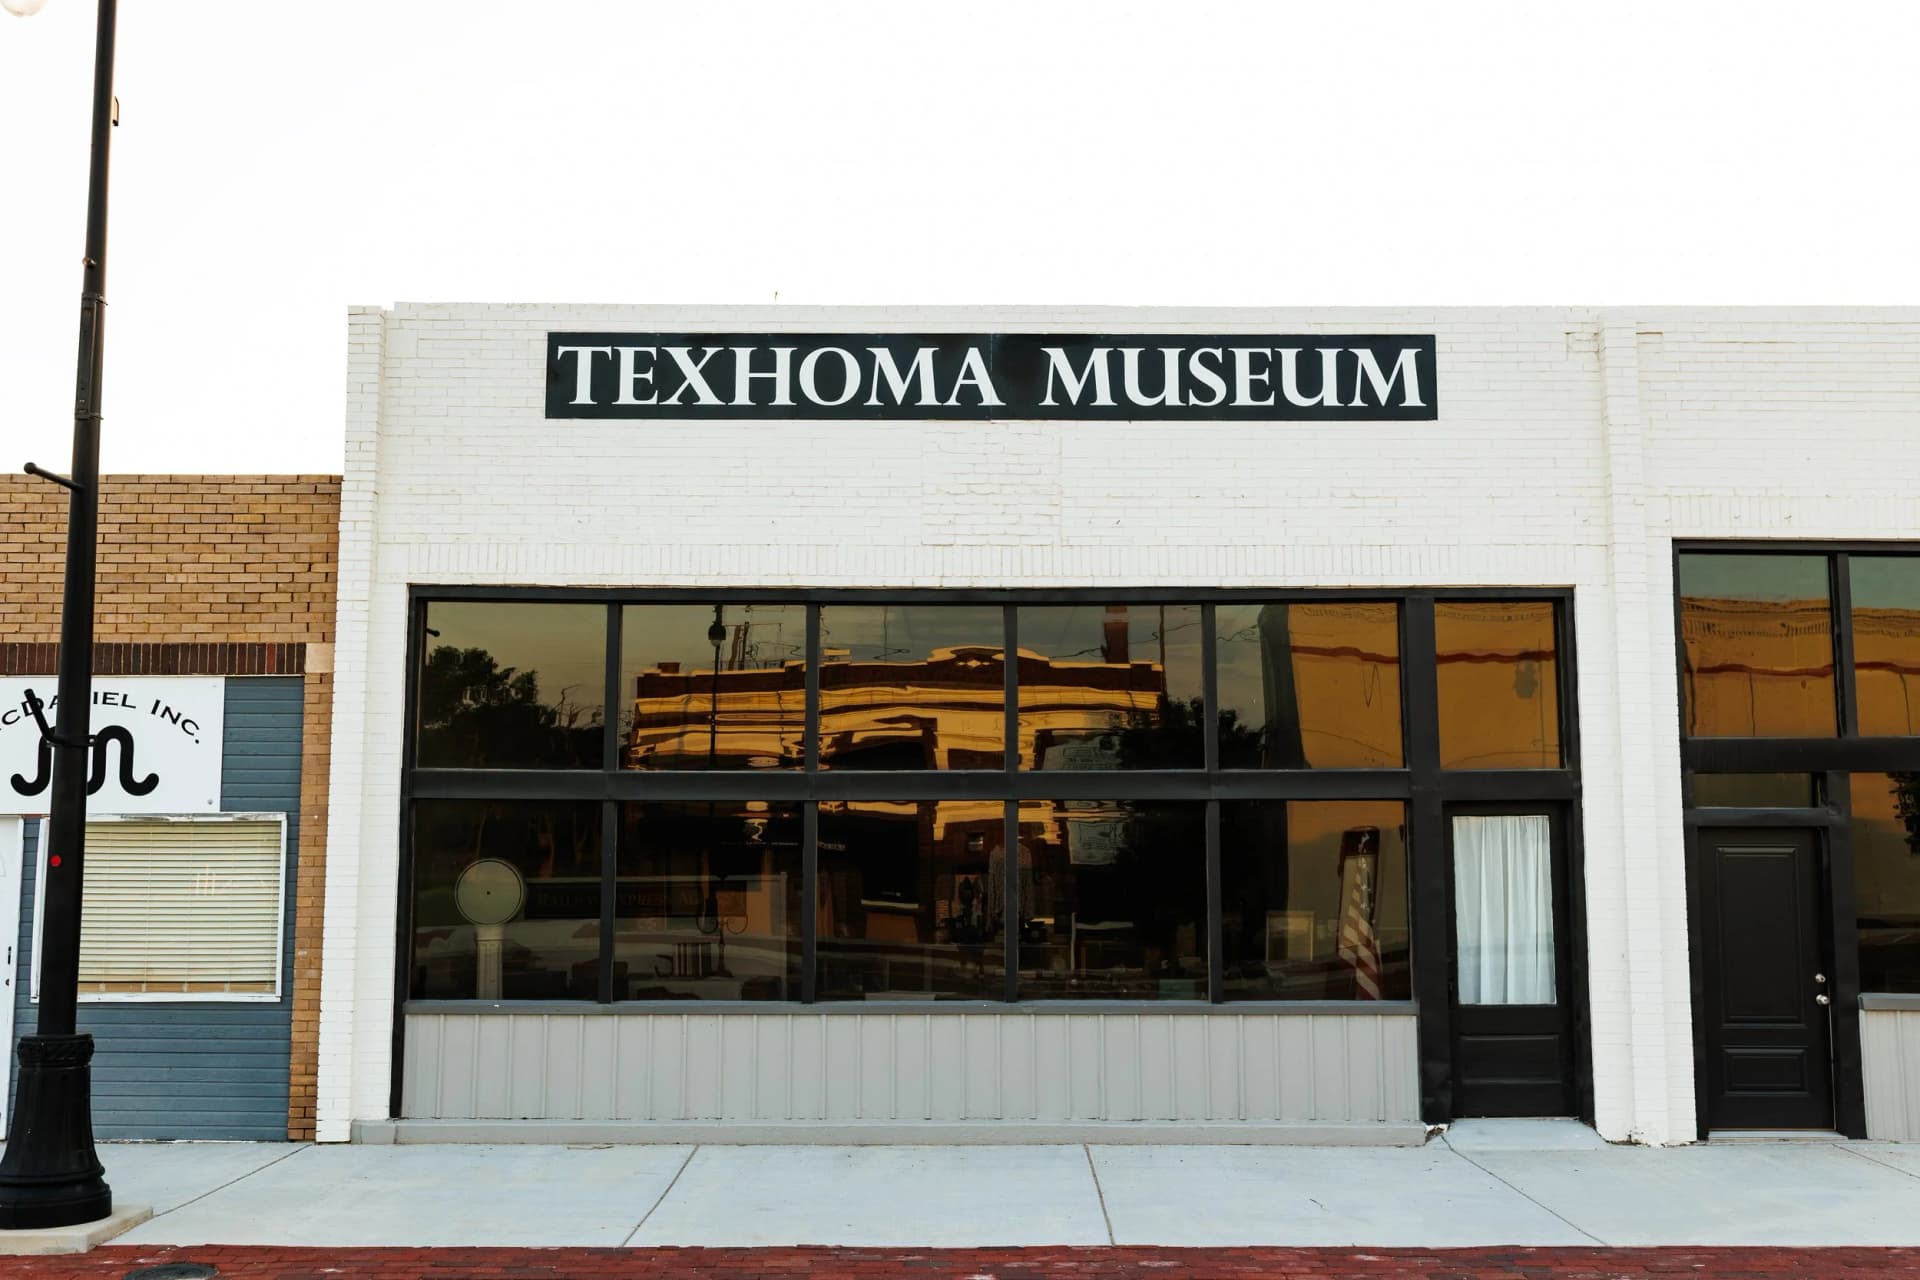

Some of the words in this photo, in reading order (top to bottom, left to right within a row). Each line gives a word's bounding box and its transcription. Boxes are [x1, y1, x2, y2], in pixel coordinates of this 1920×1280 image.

[556, 345, 1007, 409] TEXHOMA
[1039, 345, 1425, 410] MUSEUM
[150, 699, 201, 745] INC.
